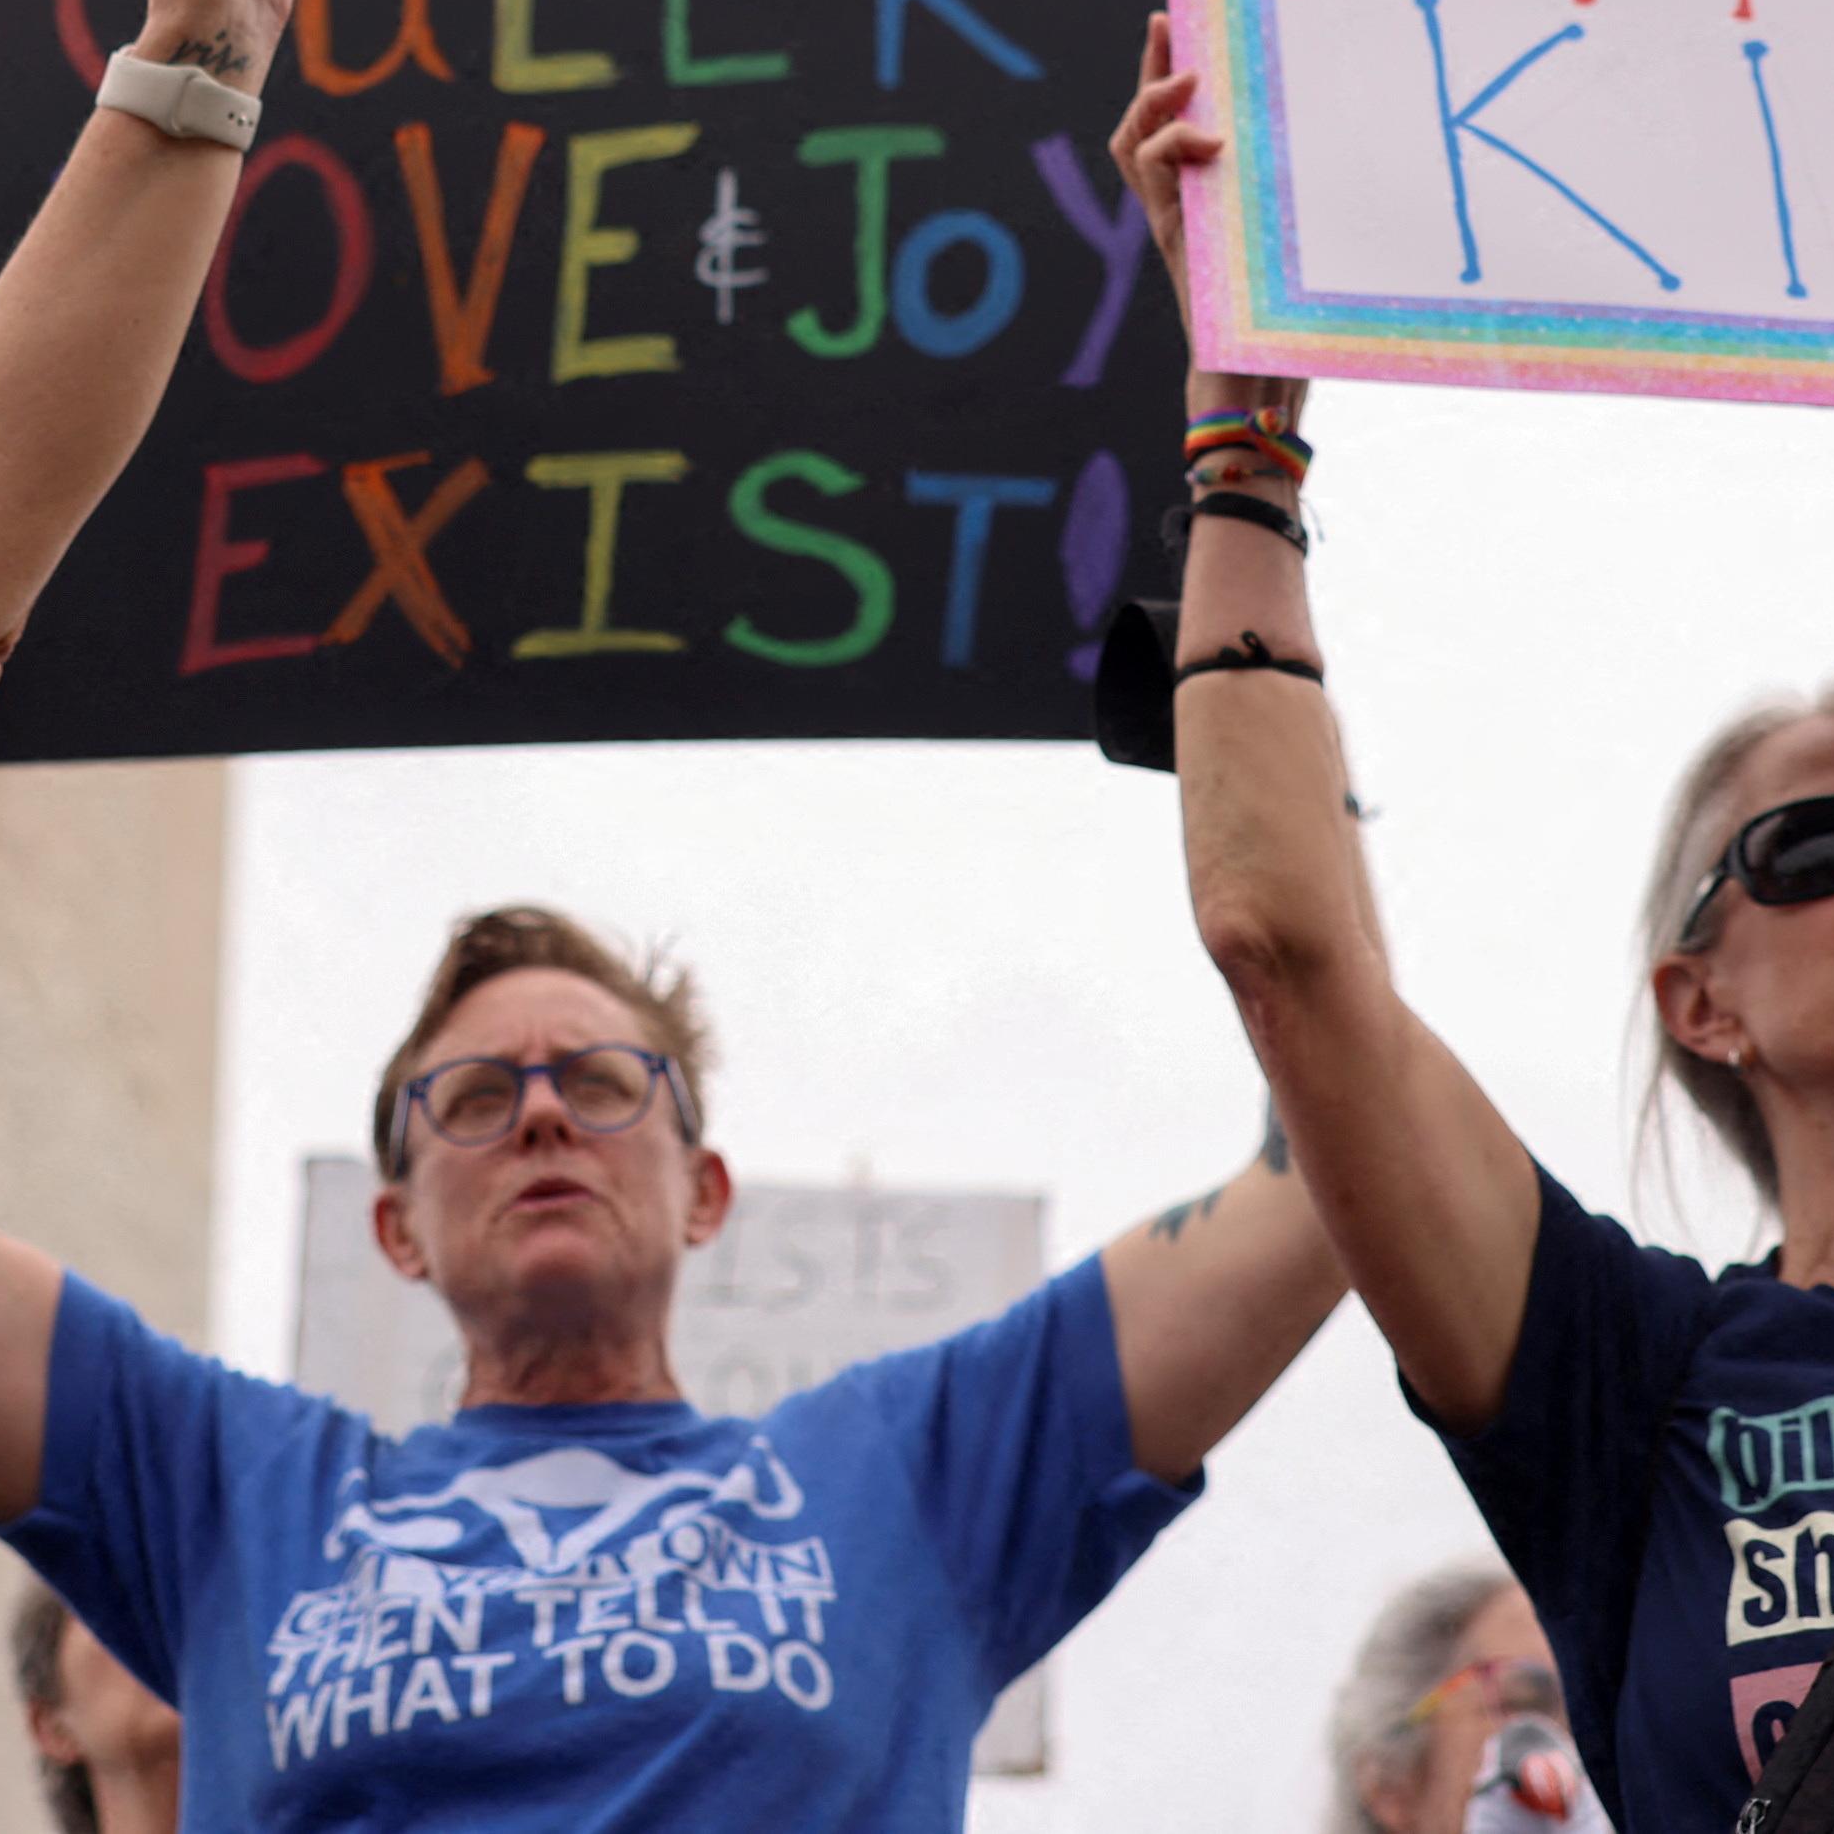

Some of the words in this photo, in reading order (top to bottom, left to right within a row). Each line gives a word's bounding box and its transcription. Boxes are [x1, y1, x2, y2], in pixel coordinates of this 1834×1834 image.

[53, 121, 703, 386] OVE
[179, 450, 1130, 684] EXIST!
[265, 1652, 517, 1773] WHAT
[542, 1630, 678, 1707] TO
[707, 1628, 834, 1712] DO
[513, 1571, 739, 1648] TELL
